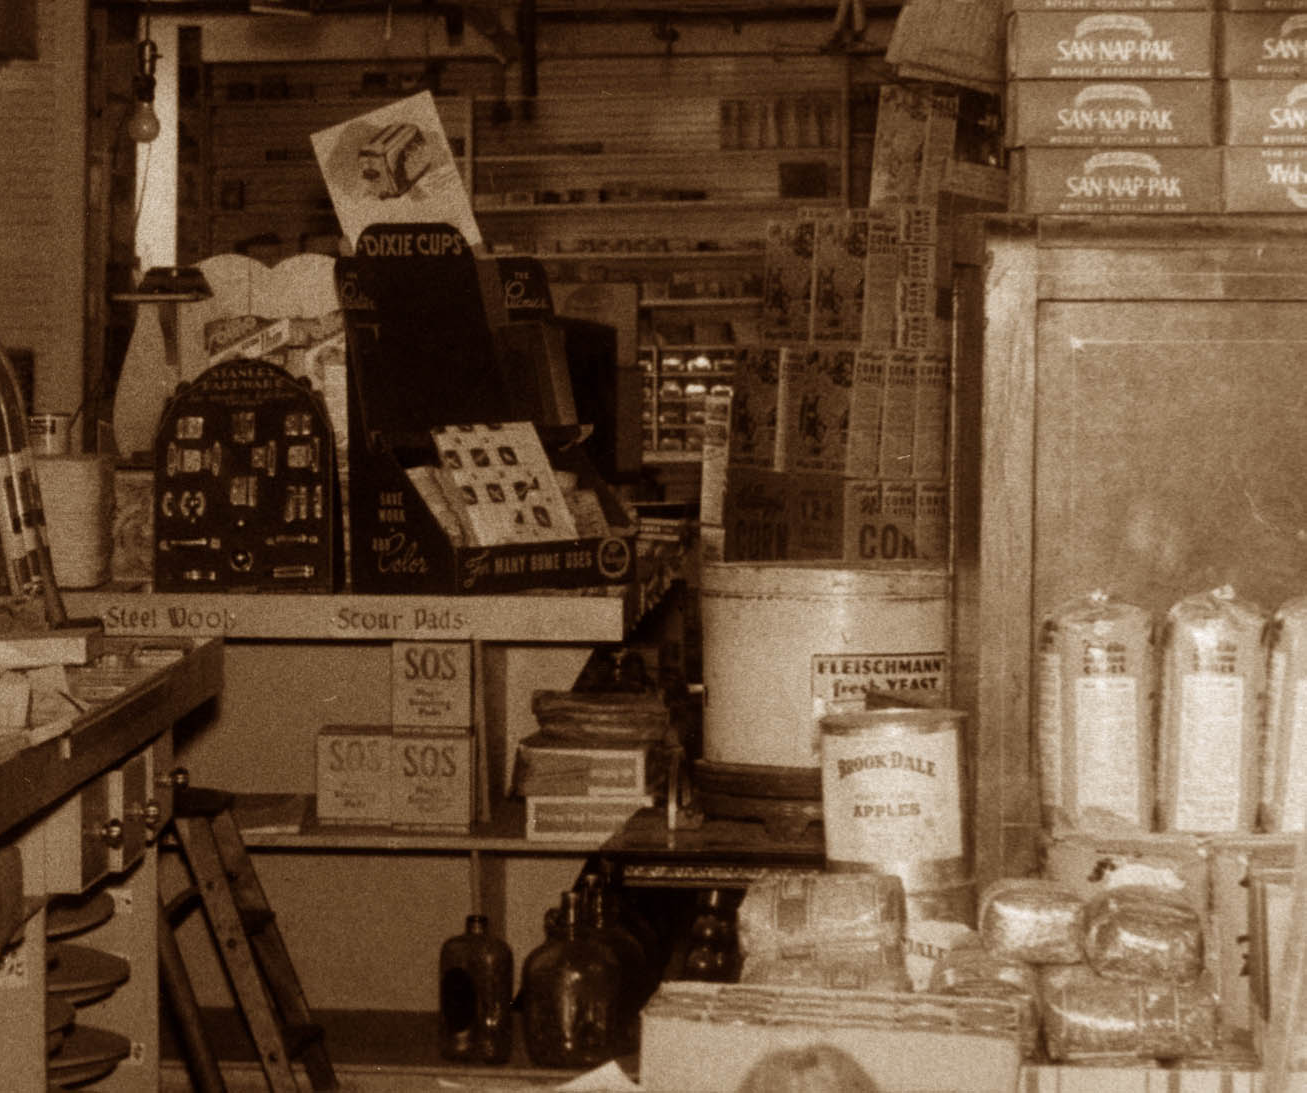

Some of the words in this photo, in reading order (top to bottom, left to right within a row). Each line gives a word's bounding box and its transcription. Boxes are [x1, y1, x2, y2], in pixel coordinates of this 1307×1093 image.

[362, 234, 413, 257] DIXIE
[415, 233, 463, 256] CUPS
[378, 532, 431, 573] Color
[494, 556, 528, 574] MANY
[565, 551, 592, 569] USES
[106, 607, 157, 629] Steel
[337, 608, 403, 630] Scour
[414, 608, 464, 630] Pads
[817, 658, 942, 675] FLEISCHMANN
[853, 802, 922, 818] APPLES
